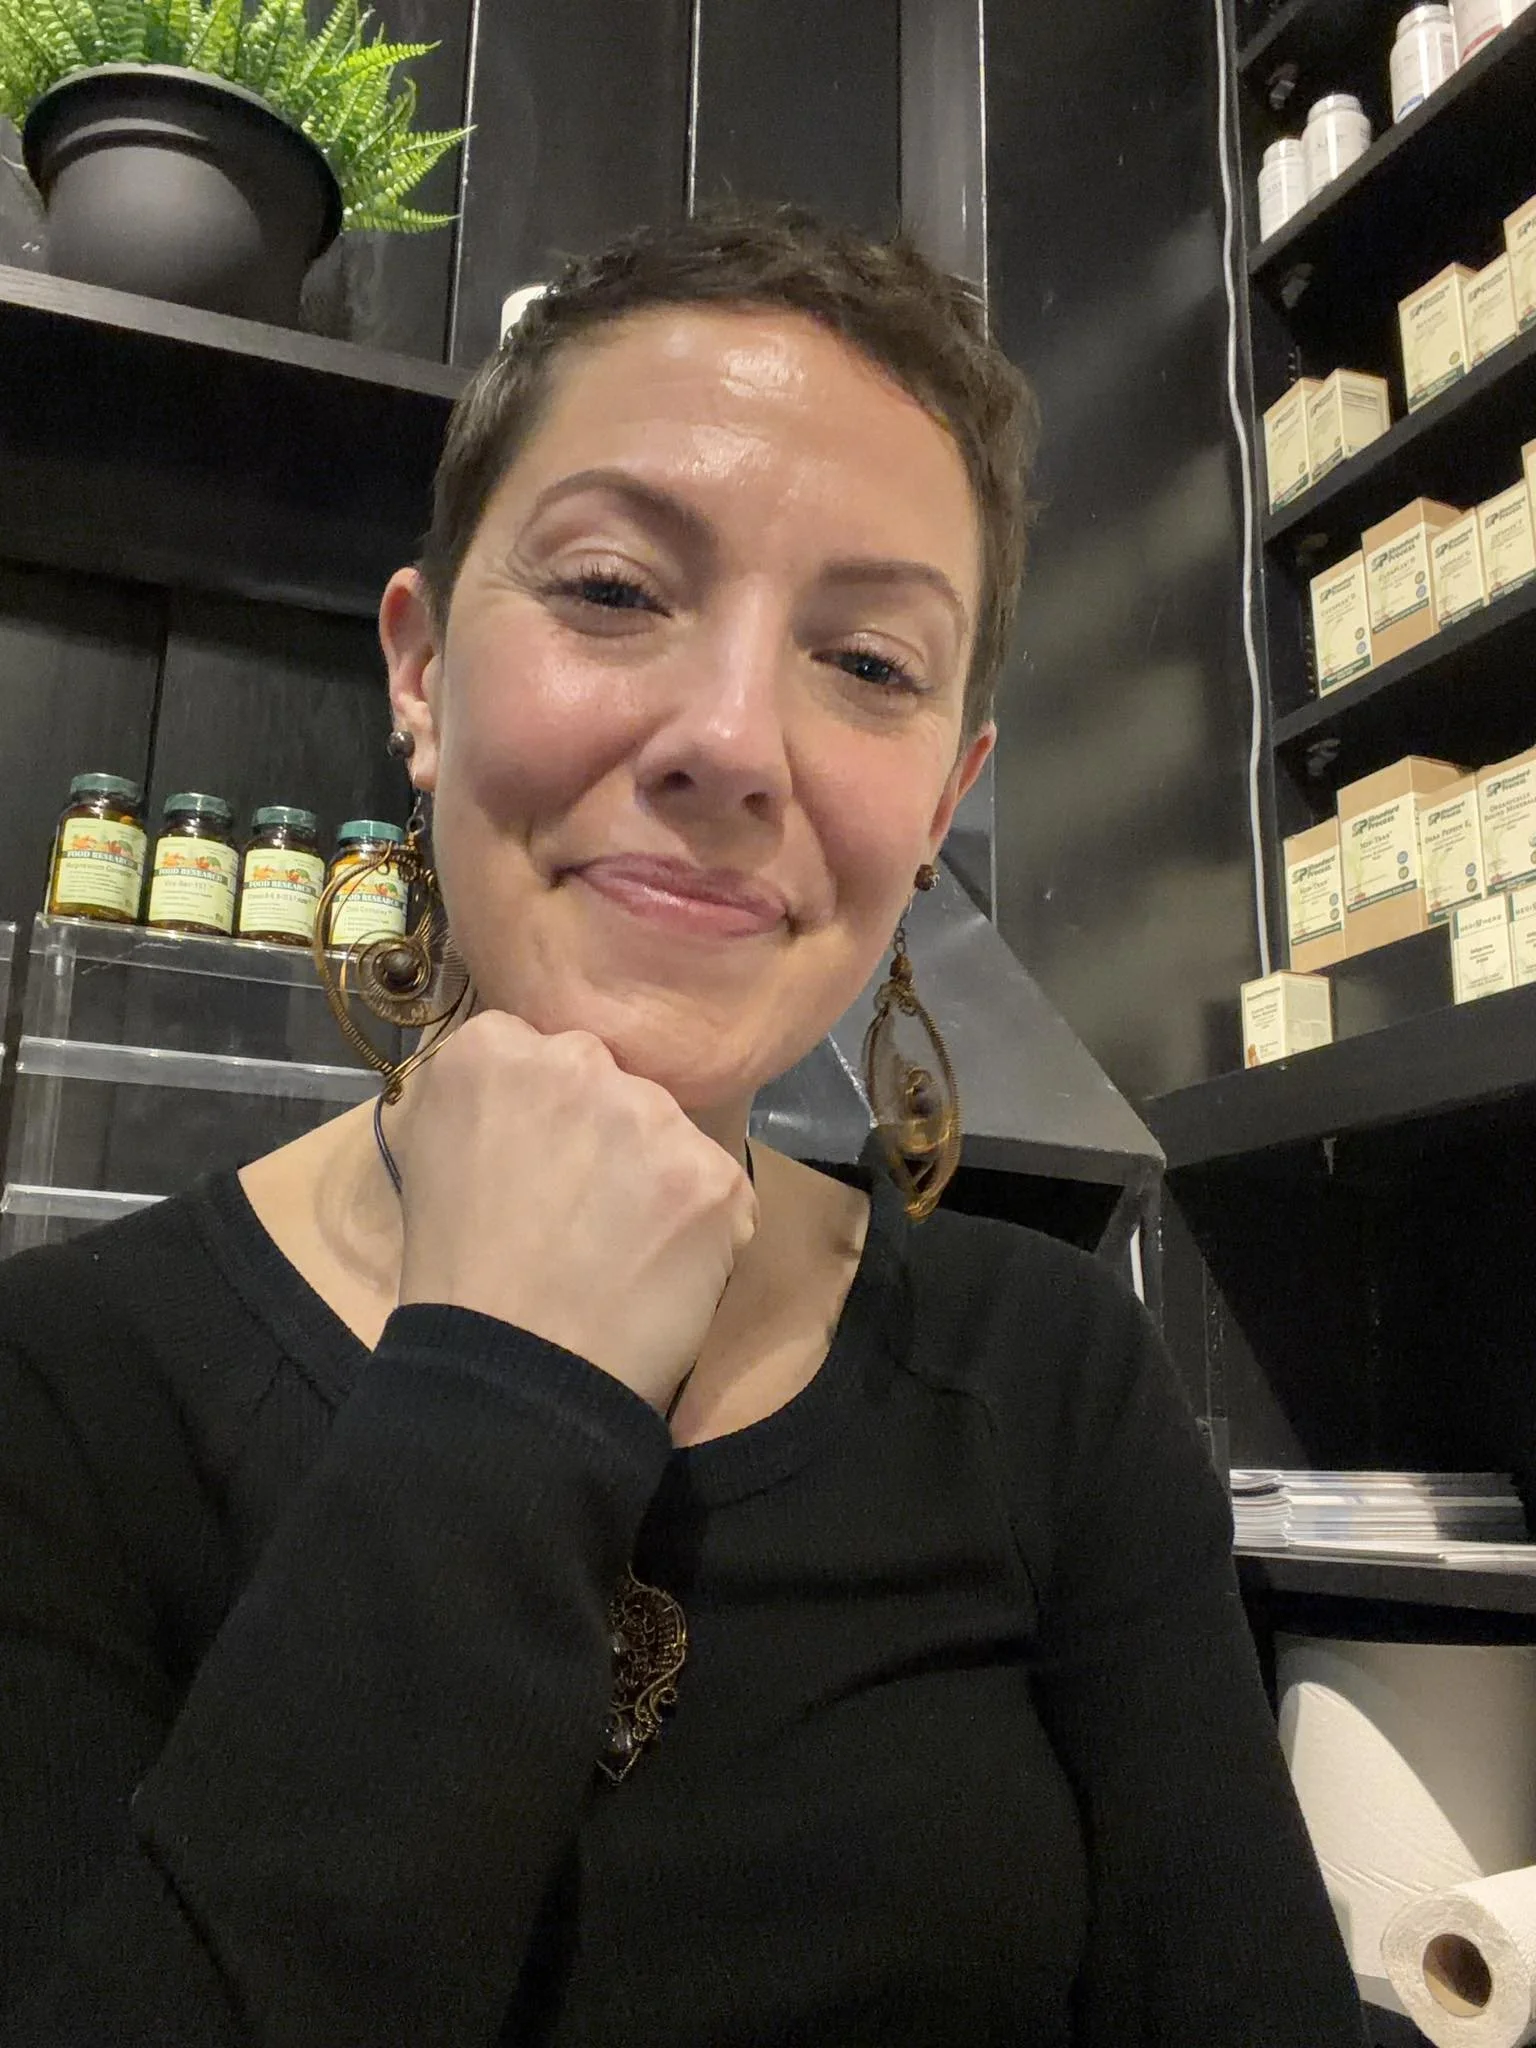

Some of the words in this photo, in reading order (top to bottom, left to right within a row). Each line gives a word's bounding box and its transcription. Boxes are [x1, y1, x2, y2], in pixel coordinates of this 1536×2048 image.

[67, 850, 91, 858] FOOD
[159, 868, 179, 876] FOOD
[249, 880, 270, 888] FOOD
